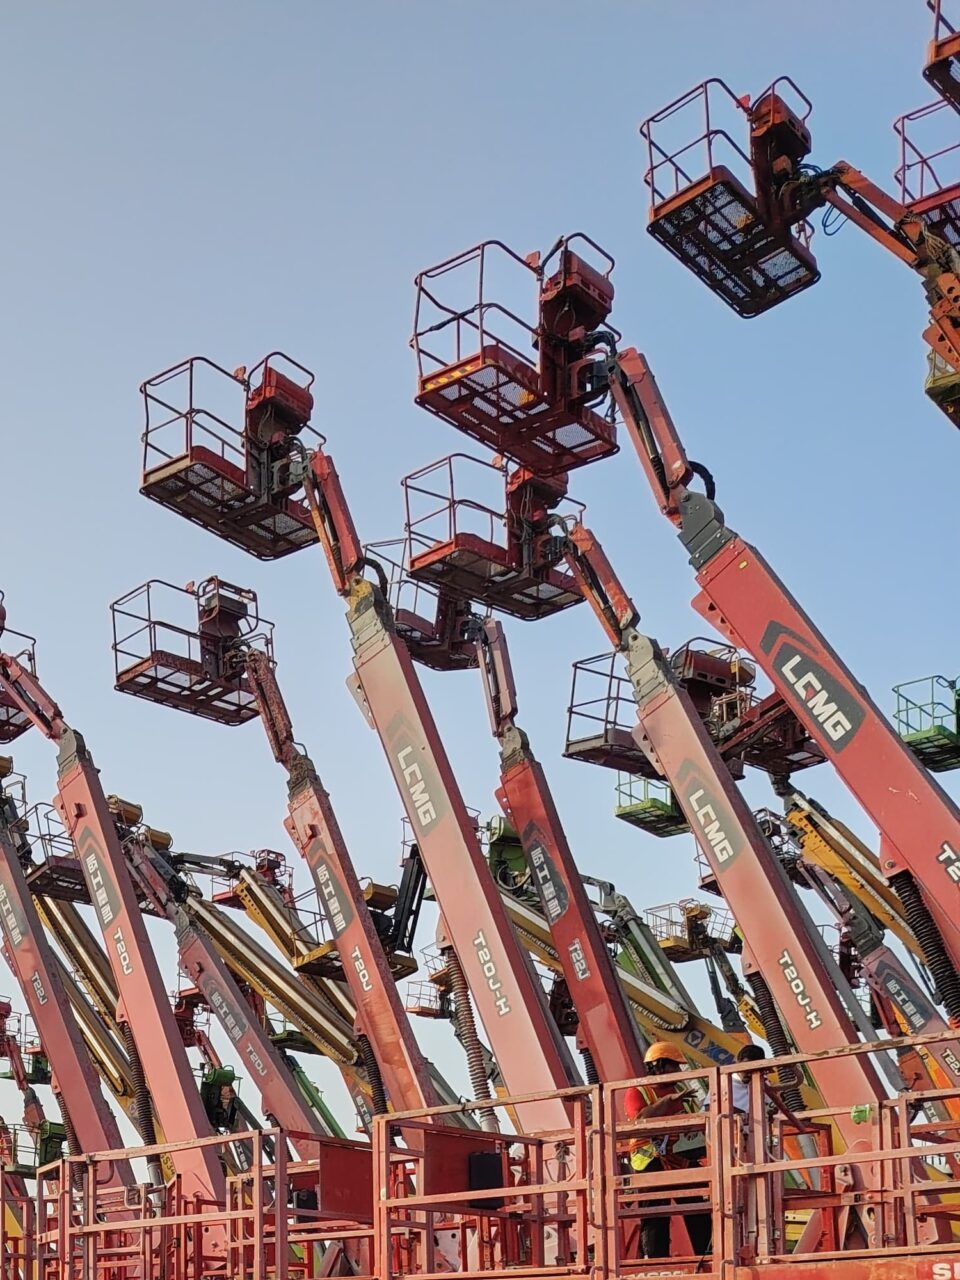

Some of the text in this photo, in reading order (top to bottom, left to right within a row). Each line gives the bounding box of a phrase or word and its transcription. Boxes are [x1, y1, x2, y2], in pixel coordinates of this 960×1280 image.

[114, 928, 132, 975] T20J
[352, 946, 372, 991] T20J
[474, 931, 510, 1016] T20J-H
[779, 951, 820, 1029] T20J-H
[246, 1043, 267, 1076] T20J
